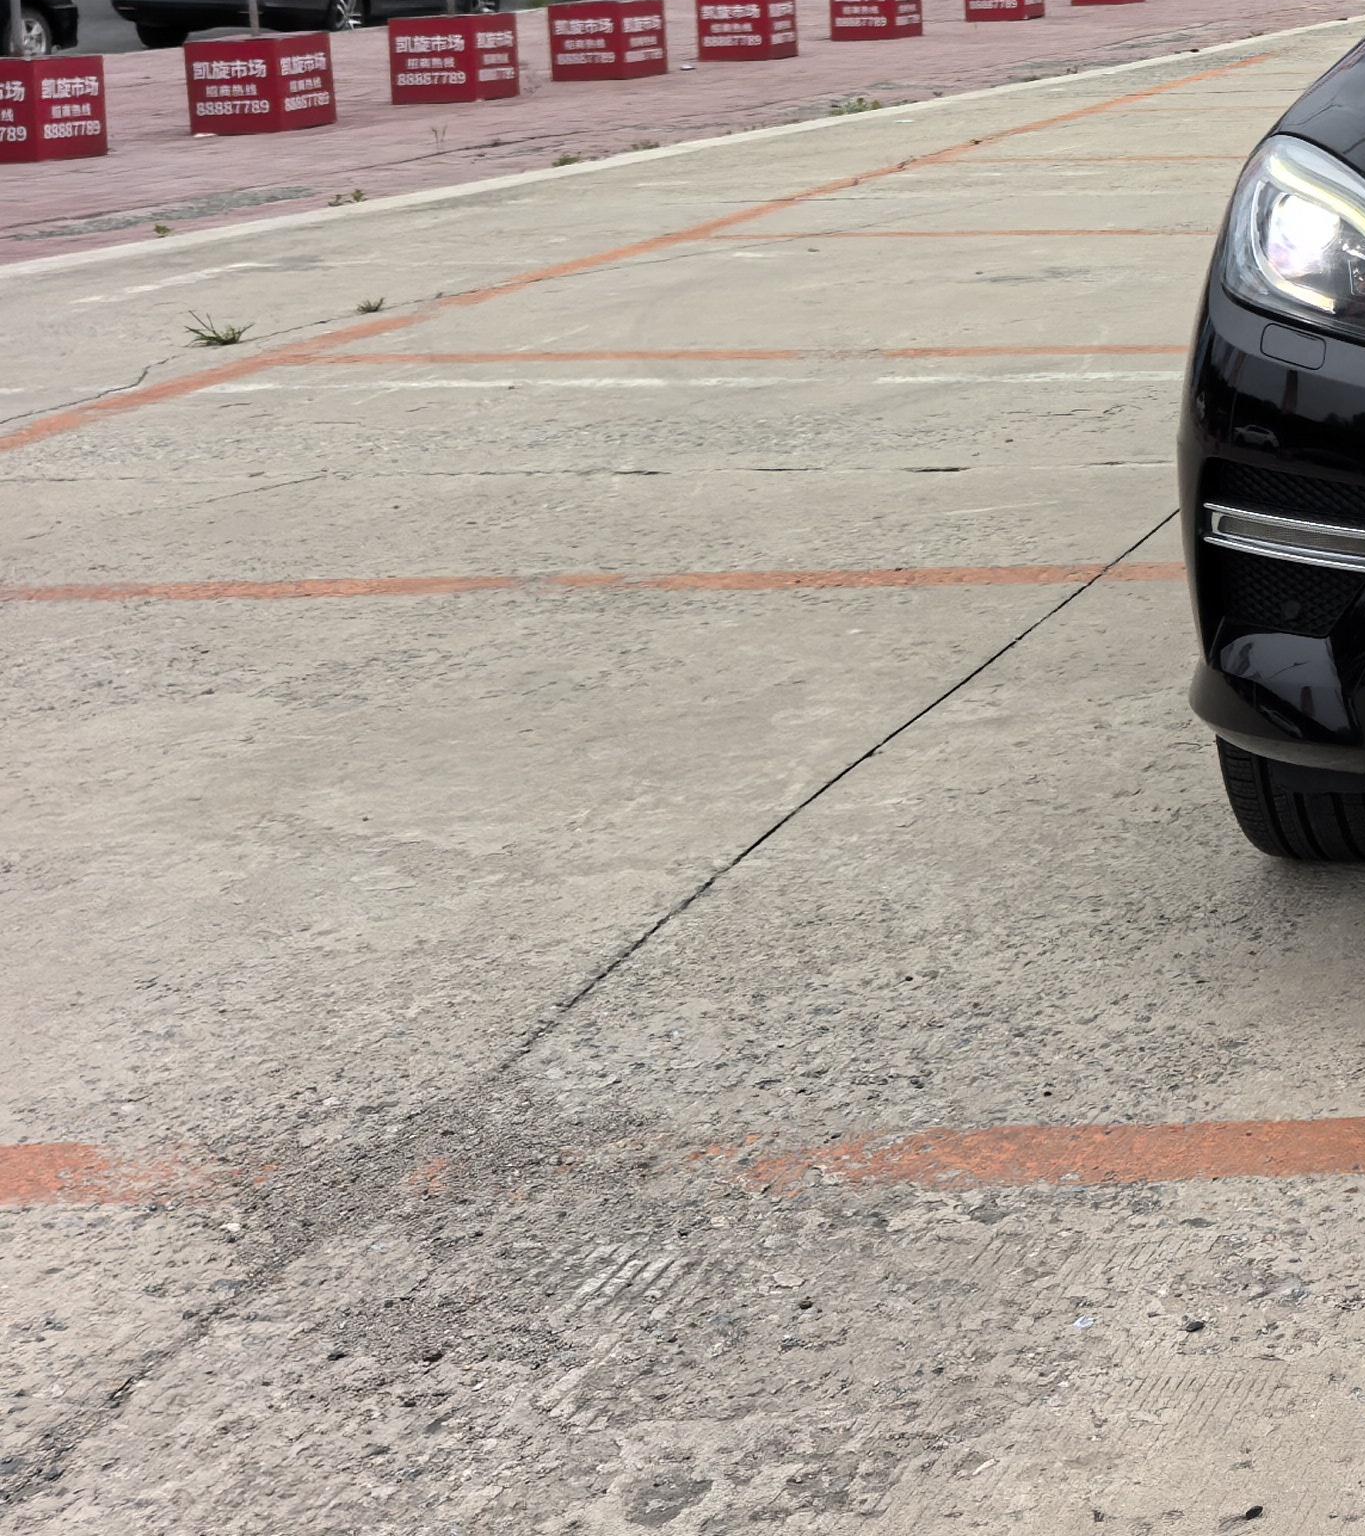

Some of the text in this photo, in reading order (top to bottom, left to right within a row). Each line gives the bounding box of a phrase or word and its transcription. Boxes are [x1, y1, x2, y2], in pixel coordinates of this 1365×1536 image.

[192, 59, 267, 80] 凯旋市场
[196, 100, 270, 116] 88887789
